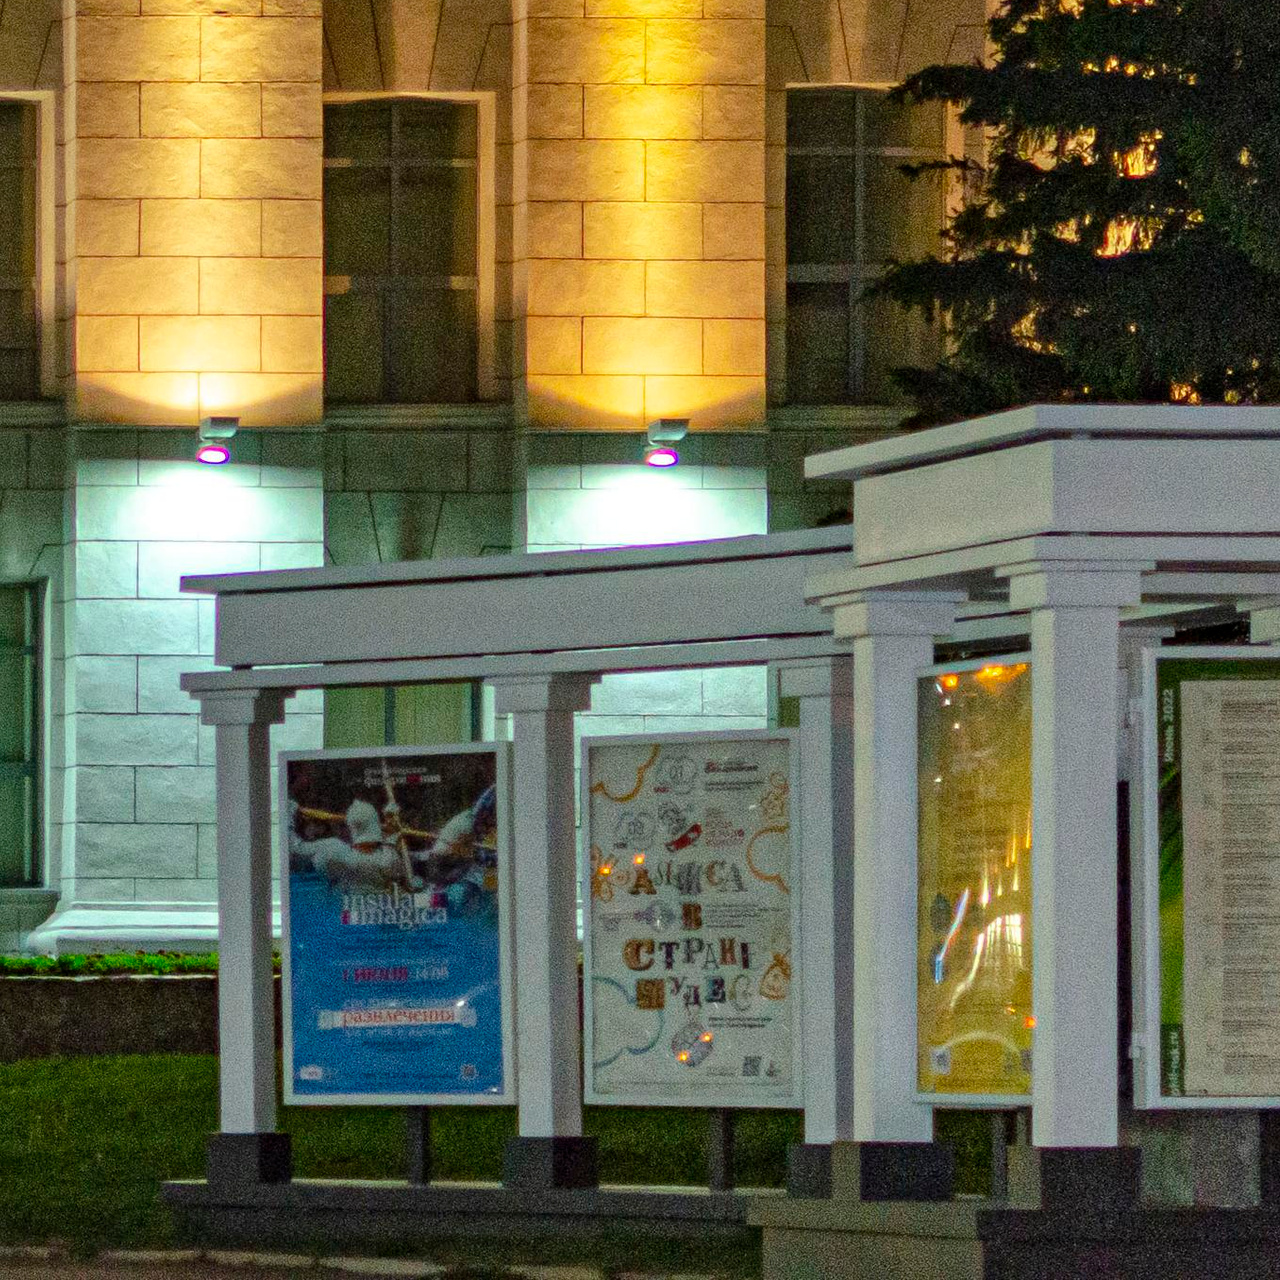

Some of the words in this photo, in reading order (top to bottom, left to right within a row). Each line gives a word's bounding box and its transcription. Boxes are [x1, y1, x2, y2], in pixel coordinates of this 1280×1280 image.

[1163, 689, 1174, 723] 2022
[341, 883, 412, 909] insula
[360, 906, 449, 930] magica
[623, 936, 758, 971] СТРАНЕ
